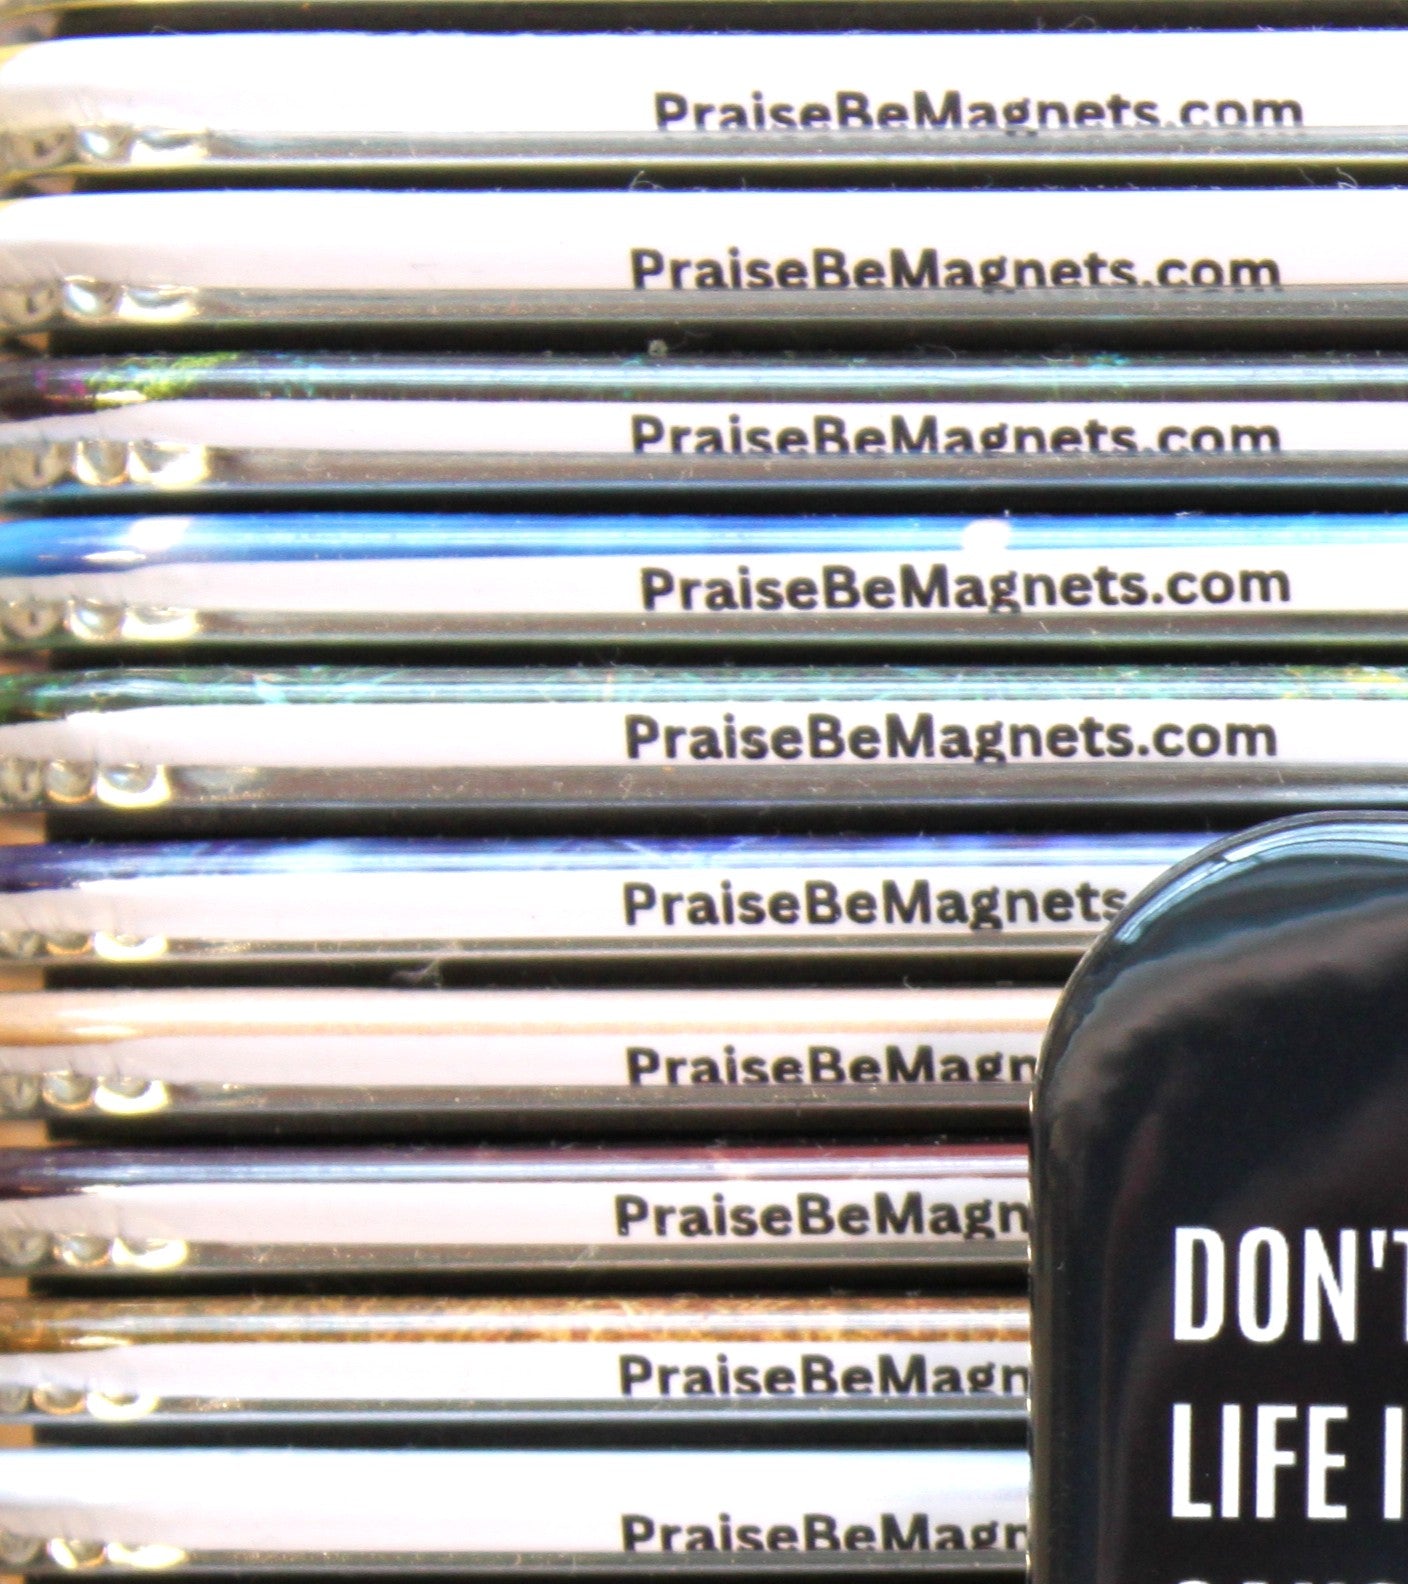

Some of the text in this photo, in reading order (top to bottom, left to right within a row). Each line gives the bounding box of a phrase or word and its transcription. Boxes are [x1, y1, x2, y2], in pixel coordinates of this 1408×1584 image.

[631, 249, 1280, 291] PraiseBeMagnets.com
[641, 565, 1290, 614] PraiseBeMagnets.com
[625, 714, 1278, 764] PraiseBeMagnets.com
[624, 880, 1125, 930] PraiseBeMagnets
[627, 1047, 1034, 1084] PraiseBeMagn
[615, 1193, 1029, 1240] PraiseBeMagn
[620, 1354, 1029, 1397] PraiseBeMagn
[1172, 1403, 1348, 1520] LIFE
[622, 1513, 1027, 1552] PraiseBeMagn
